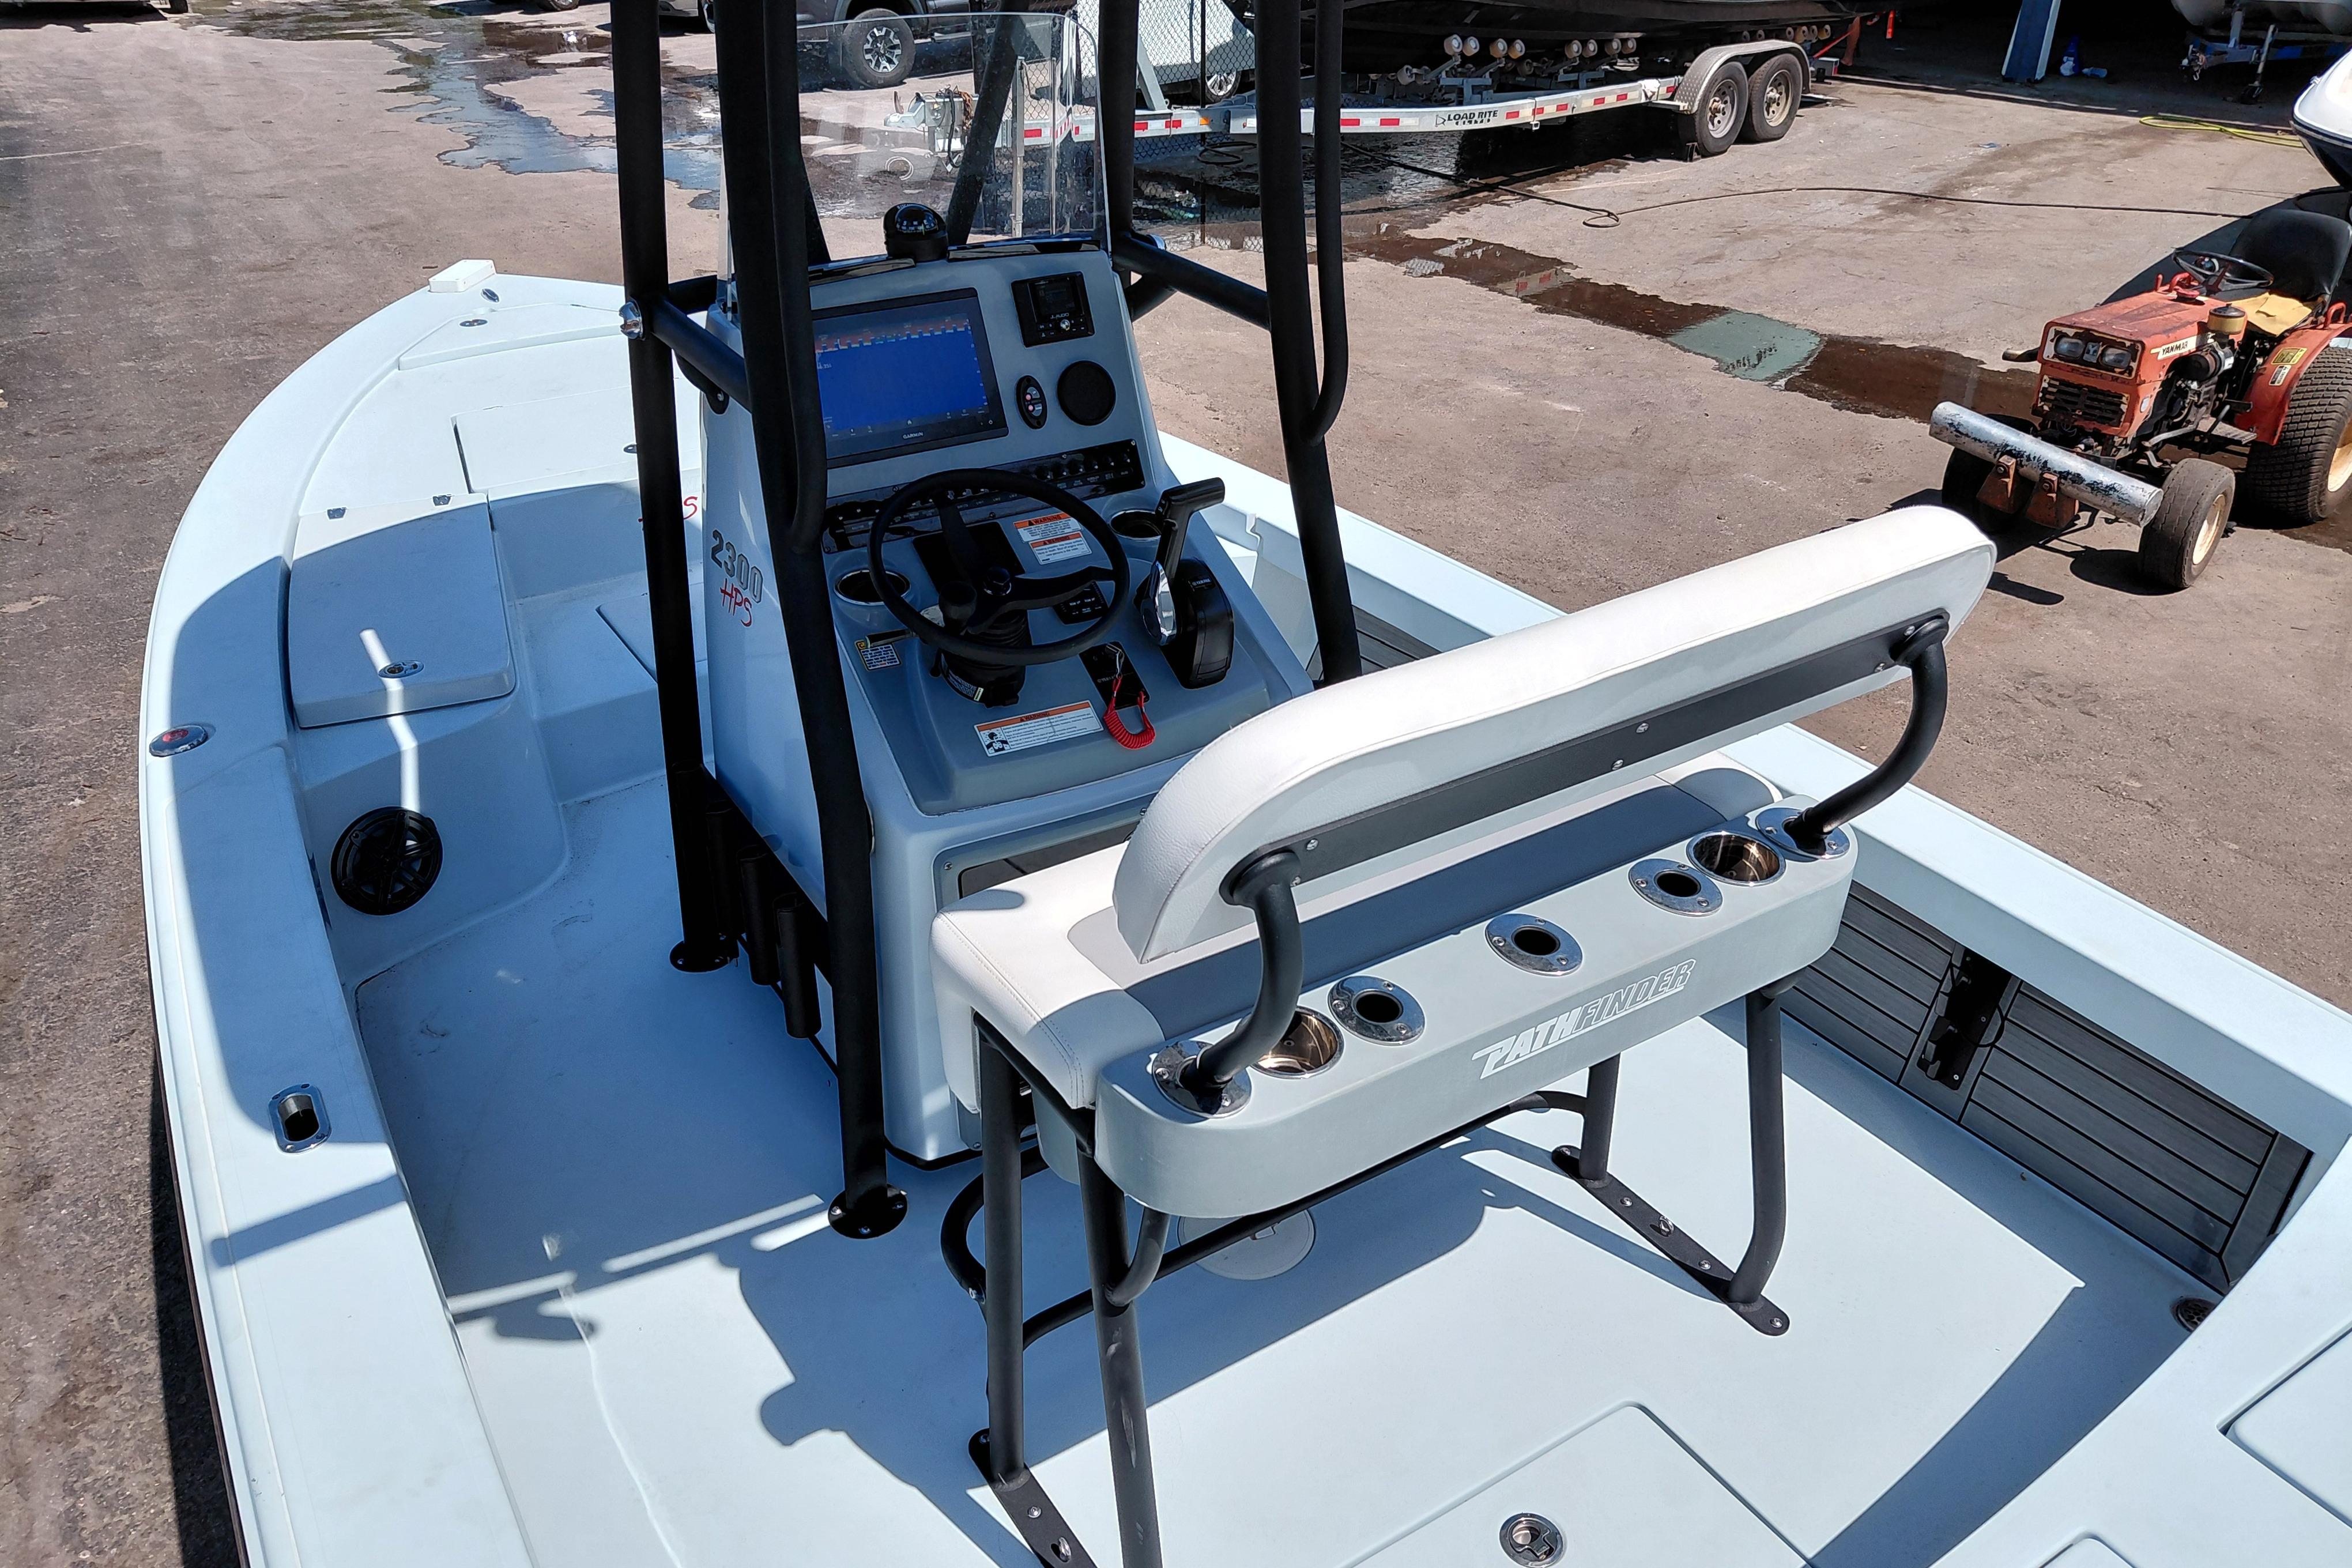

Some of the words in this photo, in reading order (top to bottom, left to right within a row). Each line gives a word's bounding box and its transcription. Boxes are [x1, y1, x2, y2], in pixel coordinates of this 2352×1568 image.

[1447, 112, 1475, 122] LOAD
[1477, 110, 1498, 119] RITE
[2162, 341, 2188, 355] YANMAR
[1034, 514, 1061, 524] WARNING
[711, 529, 763, 604] 2300
[720, 578, 752, 627] HPS
[1024, 712, 1050, 721] WARNING
[1471, 958, 1696, 1080] PATHFINDER
